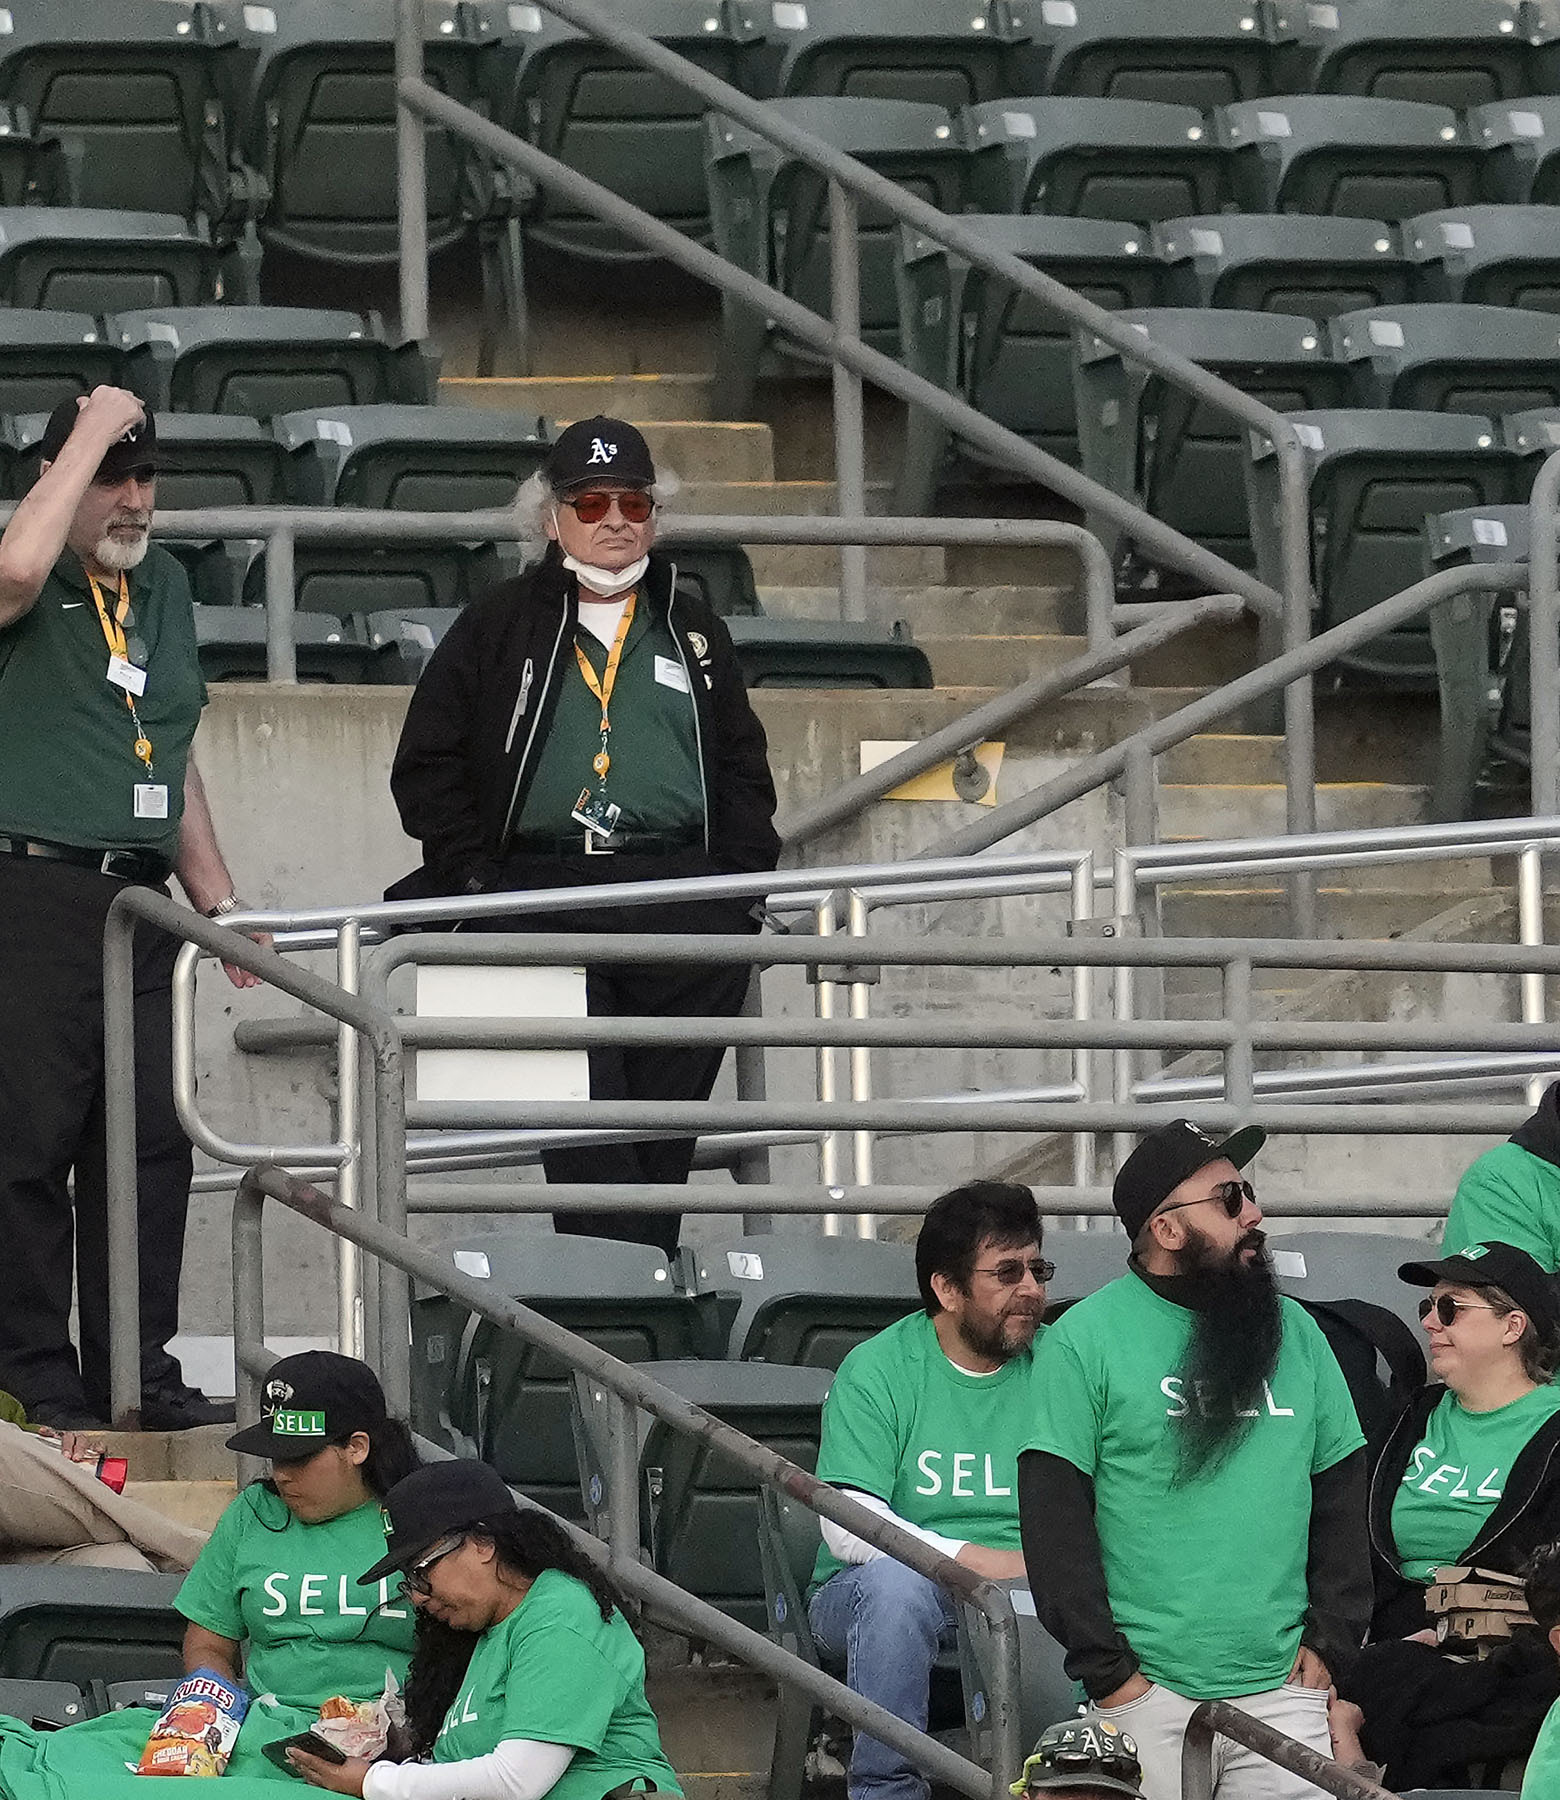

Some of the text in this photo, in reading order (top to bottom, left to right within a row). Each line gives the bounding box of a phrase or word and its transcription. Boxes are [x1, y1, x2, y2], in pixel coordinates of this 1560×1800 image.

[587, 437, 618, 464] A's
[1159, 1375, 1295, 1418] SL
[276, 1412, 324, 1434] SELL
[915, 1449, 1011, 1497] SEL
[1402, 1446, 1502, 1499] SELL
[262, 1571, 407, 1619] SELL
[173, 1679, 234, 1708] RUFFLES
[1080, 1726, 1116, 1758] A's
